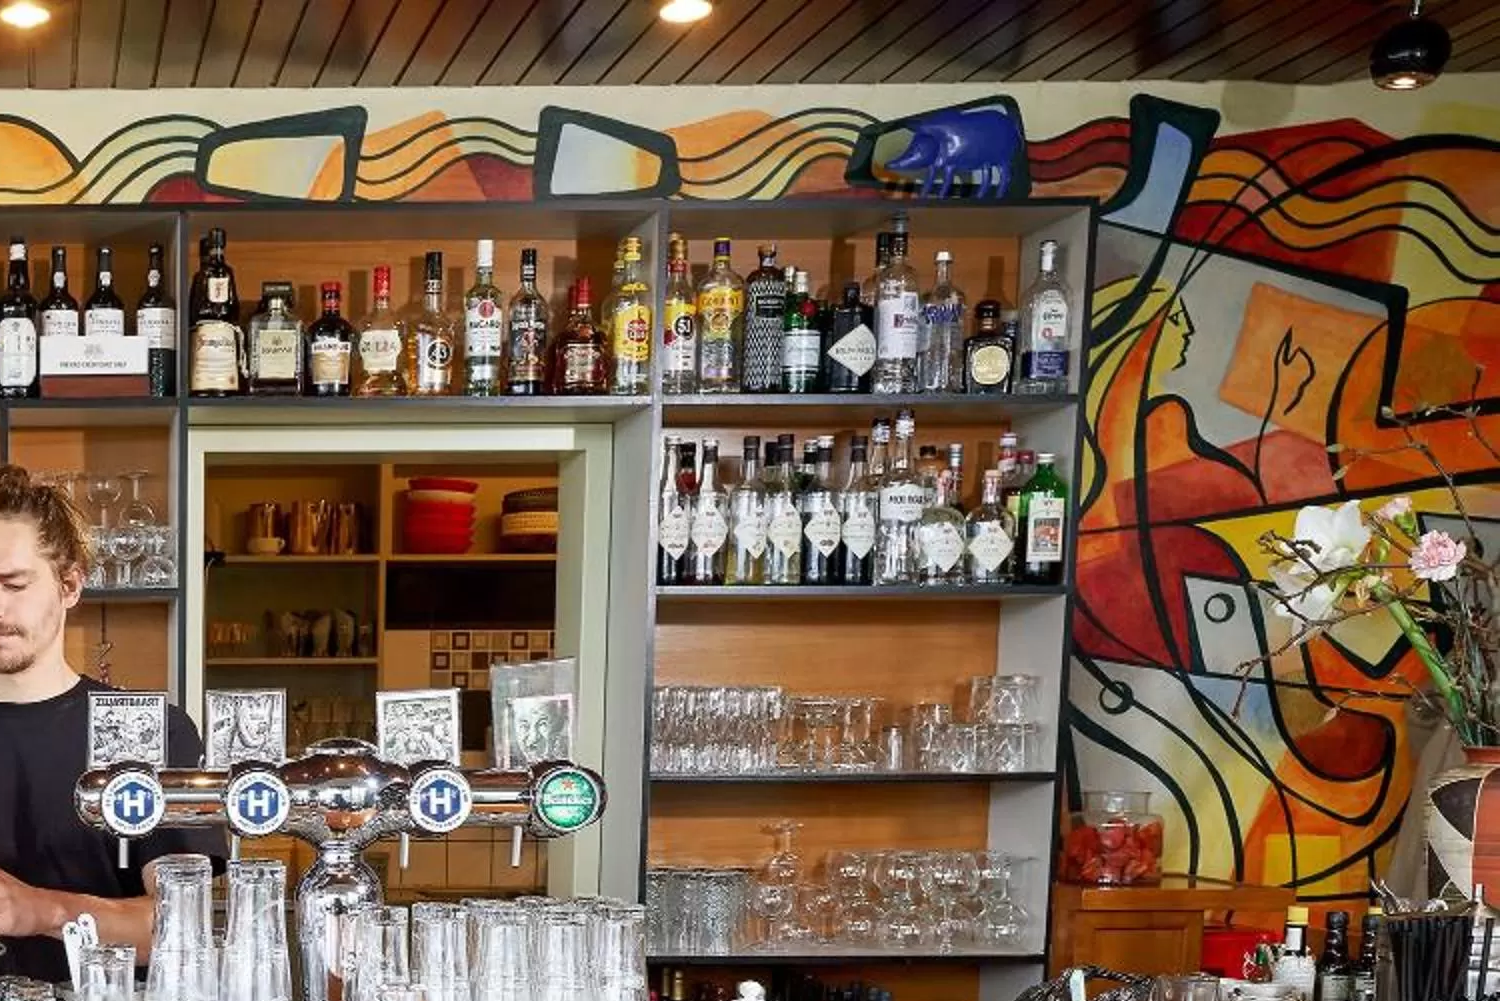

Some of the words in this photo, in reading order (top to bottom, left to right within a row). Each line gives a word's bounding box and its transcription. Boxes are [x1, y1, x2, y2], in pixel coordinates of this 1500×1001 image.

[677, 319, 691, 334] 51
[123, 790, 145, 816] H
[248, 790, 269, 816] H
[430, 788, 451, 814] H
